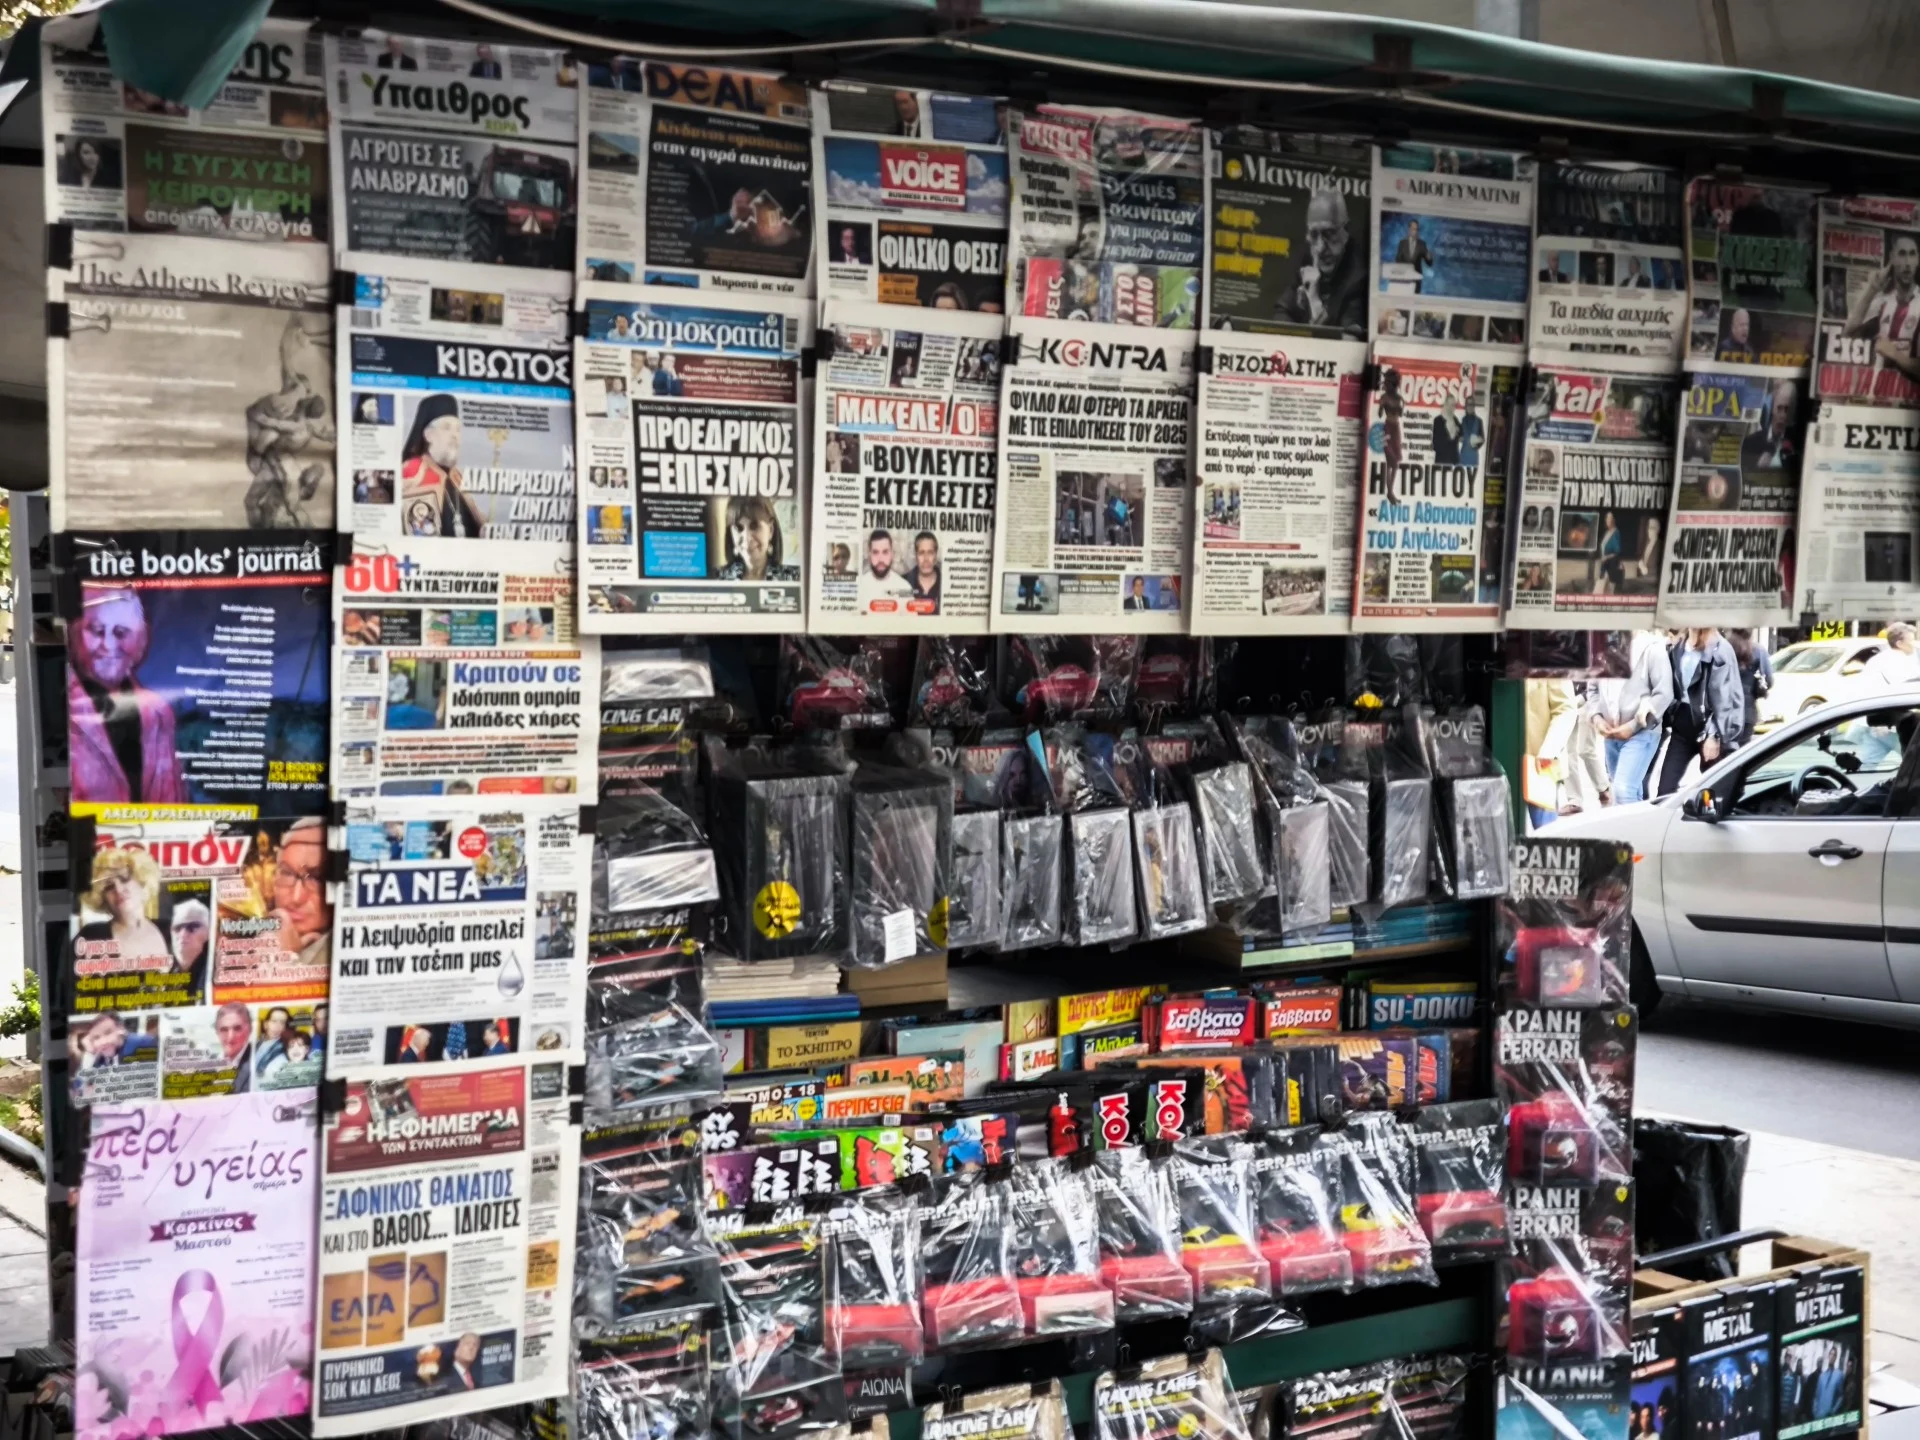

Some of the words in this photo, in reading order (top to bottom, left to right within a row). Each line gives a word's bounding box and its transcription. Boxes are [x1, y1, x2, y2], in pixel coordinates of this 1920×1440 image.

[350, 137, 435, 168] ΑΓΡΟΤΕΣ
[440, 147, 462, 170] ΣΕ
[690, 146, 737, 167] αγορά
[171, 153, 312, 186] ΣΥΓΧΥΣΗ
[351, 168, 469, 200] ΑΝΑΒΡΑΣΜΟ
[147, 179, 312, 215] ΧΕΙΡΟΤΕΡΗ
[879, 234, 950, 273] ΦΙΑΣΚΟ
[131, 265, 222, 294] Athens
[1549, 300, 1568, 318] Τα
[1570, 301, 1615, 321] πεδία
[1617, 302, 1674, 326] αιχμής
[630, 310, 781, 352] δημοκρατία
[435, 344, 572, 386] ΚΙΒΩΤΟΣ
[1010, 390, 1057, 414] ΦΥΛΛΟ
[1058, 393, 1082, 415] ΚΑΙ
[1083, 396, 1127, 418] ΦΤΕΡΟ
[1130, 398, 1145, 419] ΤΑ
[1146, 400, 1189, 422] ΑΡΧΕΙΑ
[1686, 384, 1742, 419] ΩΡΑ
[637, 414, 794, 455] ΠΡΟΕΔΡΙΚΟΣ
[1008, 415, 1027, 436] ΜΕ
[1030, 416, 1048, 438] ΤΙΣ
[1050, 417, 1127, 442] ΕΠΙΔΟΤΗΣΕΙΣ
[1129, 423, 1152, 443] ΤΟΥ
[1154, 424, 1188, 445] 2025
[1205, 428, 1251, 446] Εκτόξευση
[1253, 434, 1279, 447] τιμών
[1282, 436, 1296, 448] για
[1298, 437, 1312, 446] τον
[1314, 434, 1331, 448] λαό
[863, 444, 997, 479] «ΒΟΥΛΕΥΤΕΣ
[1205, 447, 1219, 457] και
[1222, 446, 1253, 460] κερδών
[1256, 449, 1270, 462] για
[1272, 450, 1292, 463] τους
[1294, 449, 1330, 464] ομίλους
[1563, 453, 1601, 481] ΠΟΙΟΙ
[639, 452, 795, 498] ΞΕΠΕΣΜΟΣ
[1204, 462, 1223, 475] από
[1225, 463, 1234, 473] το
[1236, 464, 1256, 476] νερό
[1264, 464, 1314, 478] εμπόρευμα
[1369, 461, 1387, 495] Η
[1398, 464, 1478, 499] ΤΡΙΓΓΟΥ
[864, 476, 995, 511] ΕΚΤΕΛΕΣΤΕΣ
[1563, 483, 1580, 507] ΤΗ
[1580, 484, 1612, 508] ΧΗΡΑ
[862, 508, 937, 532] ΣΥΜΒΟΛΑΙΩΝ
[1413, 501, 1477, 526] Αθανασία
[1367, 529, 1397, 549] του
[89, 548, 136, 577] the
[236, 546, 323, 579] journal
[1667, 562, 1688, 594] ΣΤΑ
[453, 661, 547, 686] Κρατούν
[553, 665, 581, 682] σε
[452, 689, 520, 708] ιδιότυπη
[524, 689, 581, 708] ομηρία
[450, 710, 525, 729] χιλιάδες
[529, 711, 581, 729] χήρες
[1514, 845, 1581, 870] ΡΑΝΗ
[360, 872, 404, 905] ΤΑ
[411, 869, 482, 903] ΝΕΑ
[340, 926, 355, 949] Η
[360, 920, 455, 951] λειψυδρία
[461, 917, 525, 942] απειλεί
[339, 959, 369, 977] και
[376, 957, 405, 975] την
[411, 949, 464, 973] τσέπη
[470, 950, 502, 972] μας
[1270, 1008, 1332, 1028] Σάββατο
[1373, 996, 1477, 1023] SU-DOKU
[777, 1046, 793, 1058] ΤΟ
[795, 1039, 853, 1057] ΣΚΗΠΤΡΟ
[747, 1087, 793, 1104] ΟΜΟΣ
[799, 1084, 816, 1097] 18
[93, 1113, 182, 1171] περί
[381, 1139, 406, 1156] ΤΩΝ
[408, 1133, 483, 1153] ΣΥΝΤΑΚΤΩΝ
[174, 1140, 308, 1200] υγείας
[324, 1178, 423, 1222] ΞΑΦΝΙΚΟΣ
[429, 1168, 515, 1207] ΘΑΝΑΤΟΣ
[1514, 1187, 1581, 1209] ΡΑΝΗ
[163, 1214, 244, 1236] Καρκίνος
[323, 1232, 345, 1254] ΚΑΙ
[346, 1229, 369, 1251] ΣΤΟ
[371, 1210, 449, 1249] ΒΑΘΟΣ...
[454, 1197, 522, 1237] ΙΔΙΩΤΕΣ
[1512, 1214, 1581, 1236] ERRARI
[173, 1236, 232, 1252] Μαστού
[330, 1294, 397, 1324] ΕΛΤΑ
[1795, 1292, 1845, 1324] METAL
[1703, 1311, 1754, 1345] METAL
[1630, 1337, 1660, 1366] TAL
[324, 1356, 385, 1382] ΠΥΡΗΝΙΚΟ
[323, 1380, 349, 1401] ΣΟΚ
[350, 1377, 372, 1397] ΚΑΙ
[374, 1370, 402, 1394] ΔΕΟΣ
